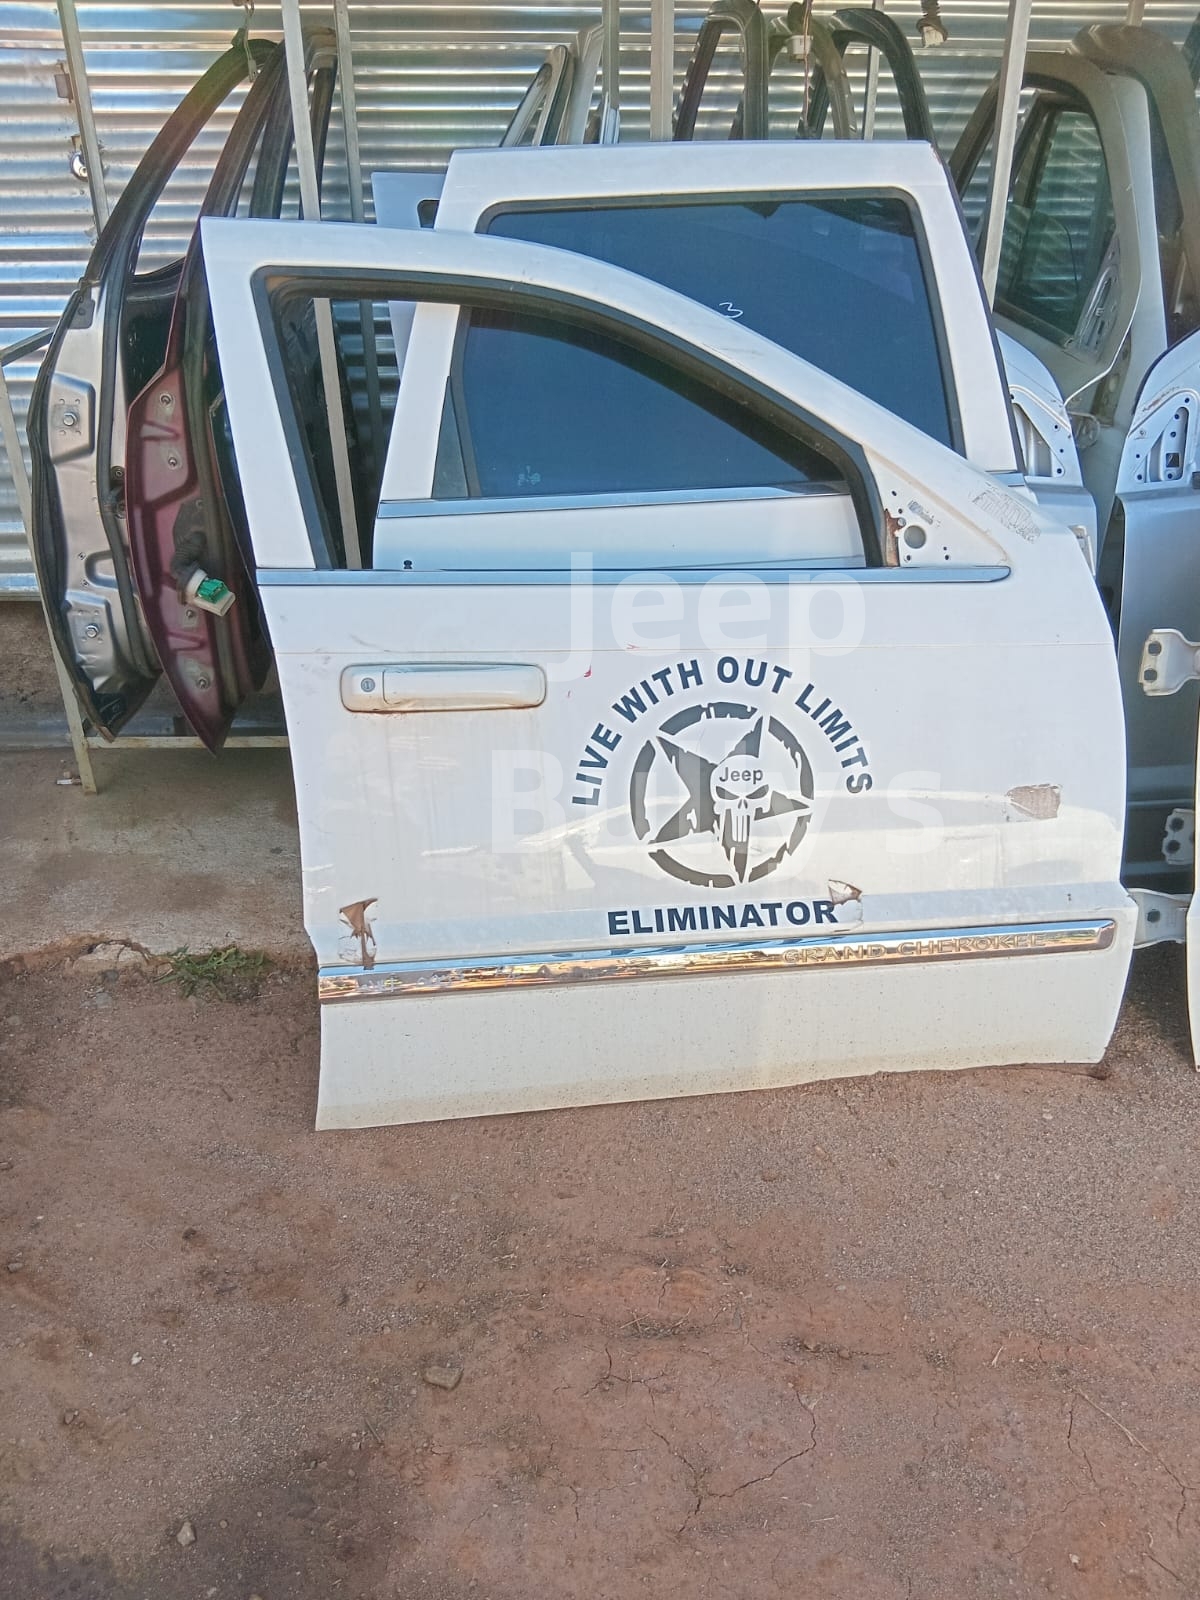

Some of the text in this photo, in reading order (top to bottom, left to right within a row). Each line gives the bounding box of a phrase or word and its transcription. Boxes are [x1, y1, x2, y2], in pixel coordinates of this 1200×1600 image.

[571, 656, 873, 806] LIVE WITH OUT LIMITS
[719, 767, 764, 785] Jeep
[607, 900, 838, 935] ELIMINATOR
[782, 932, 1047, 963] GRAND CHEROKEE
